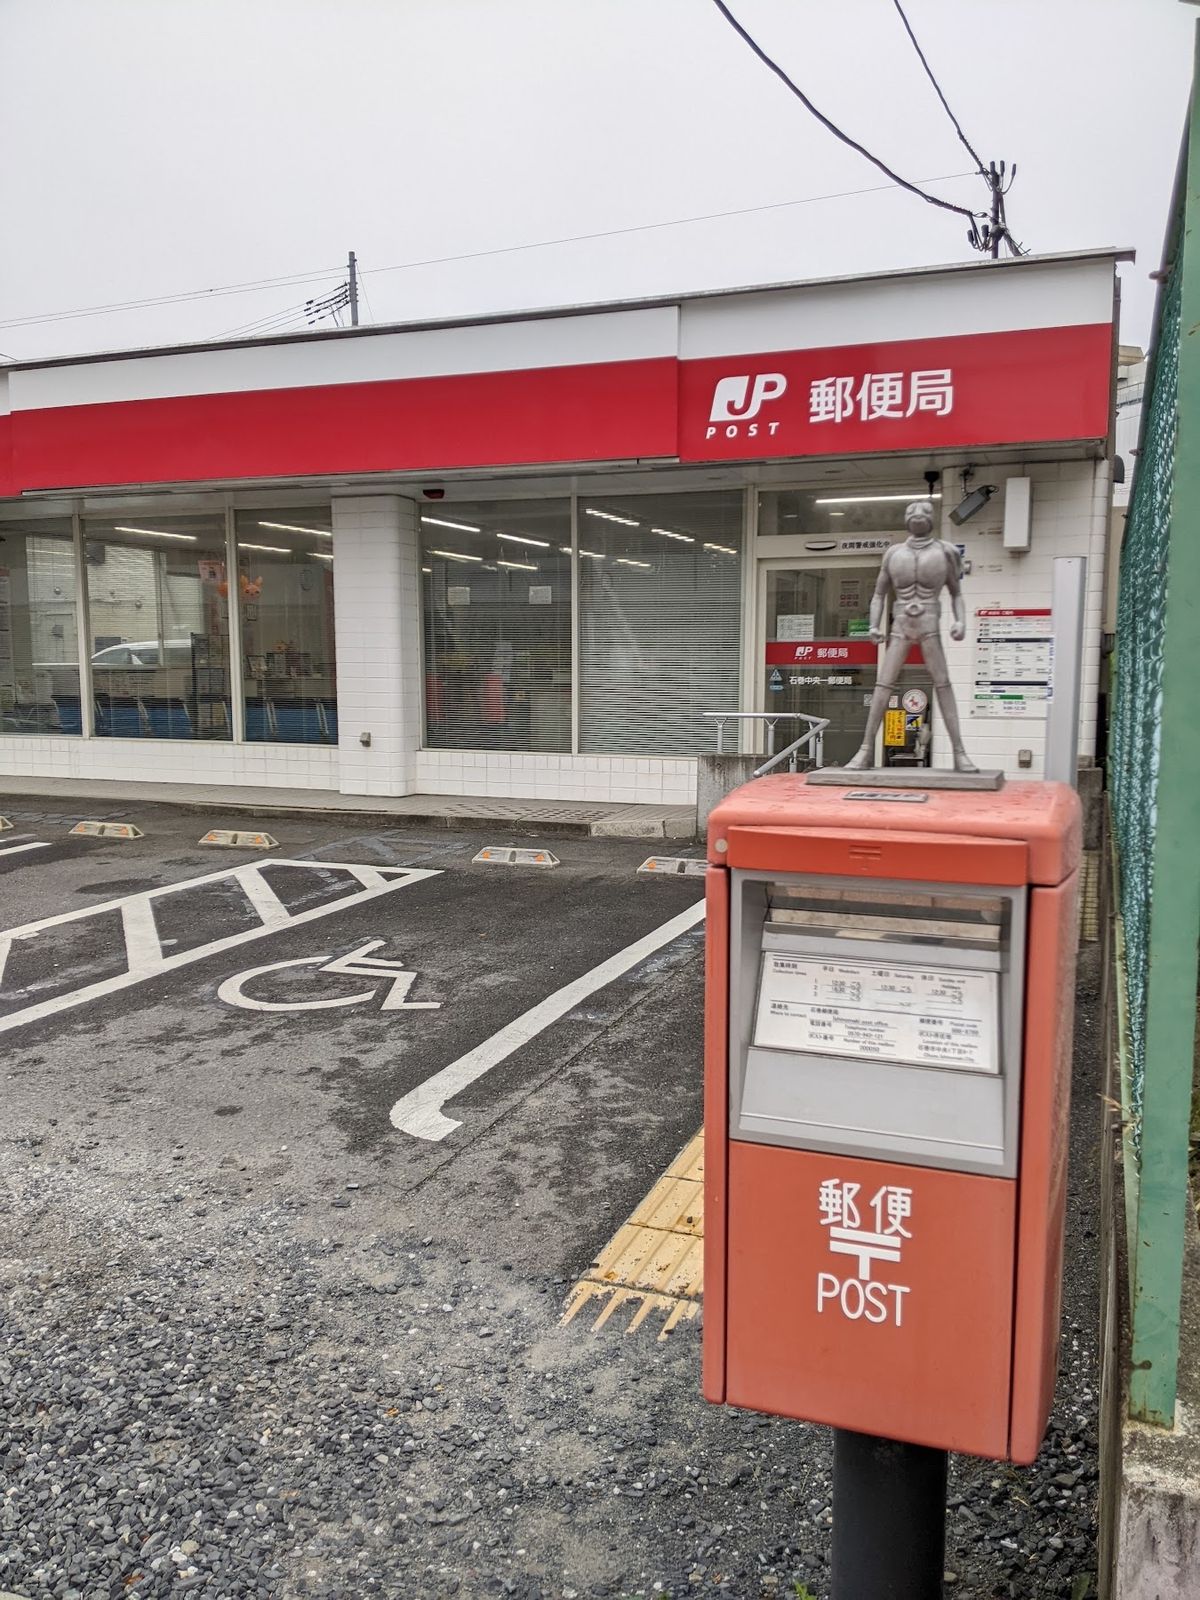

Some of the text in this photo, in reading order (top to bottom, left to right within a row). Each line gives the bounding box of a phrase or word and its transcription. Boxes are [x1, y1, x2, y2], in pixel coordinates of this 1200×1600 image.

[709, 373, 787, 422] JP
[809, 369, 954, 423] 郵便局
[705, 421, 780, 440] POST
[795, 646, 813, 656] JP
[817, 647, 848, 658] 郵便局
[789, 676, 852, 685] 石巻中央一郵便局
[818, 1178, 913, 1239] 郵便
[817, 1272, 911, 1327] POST
